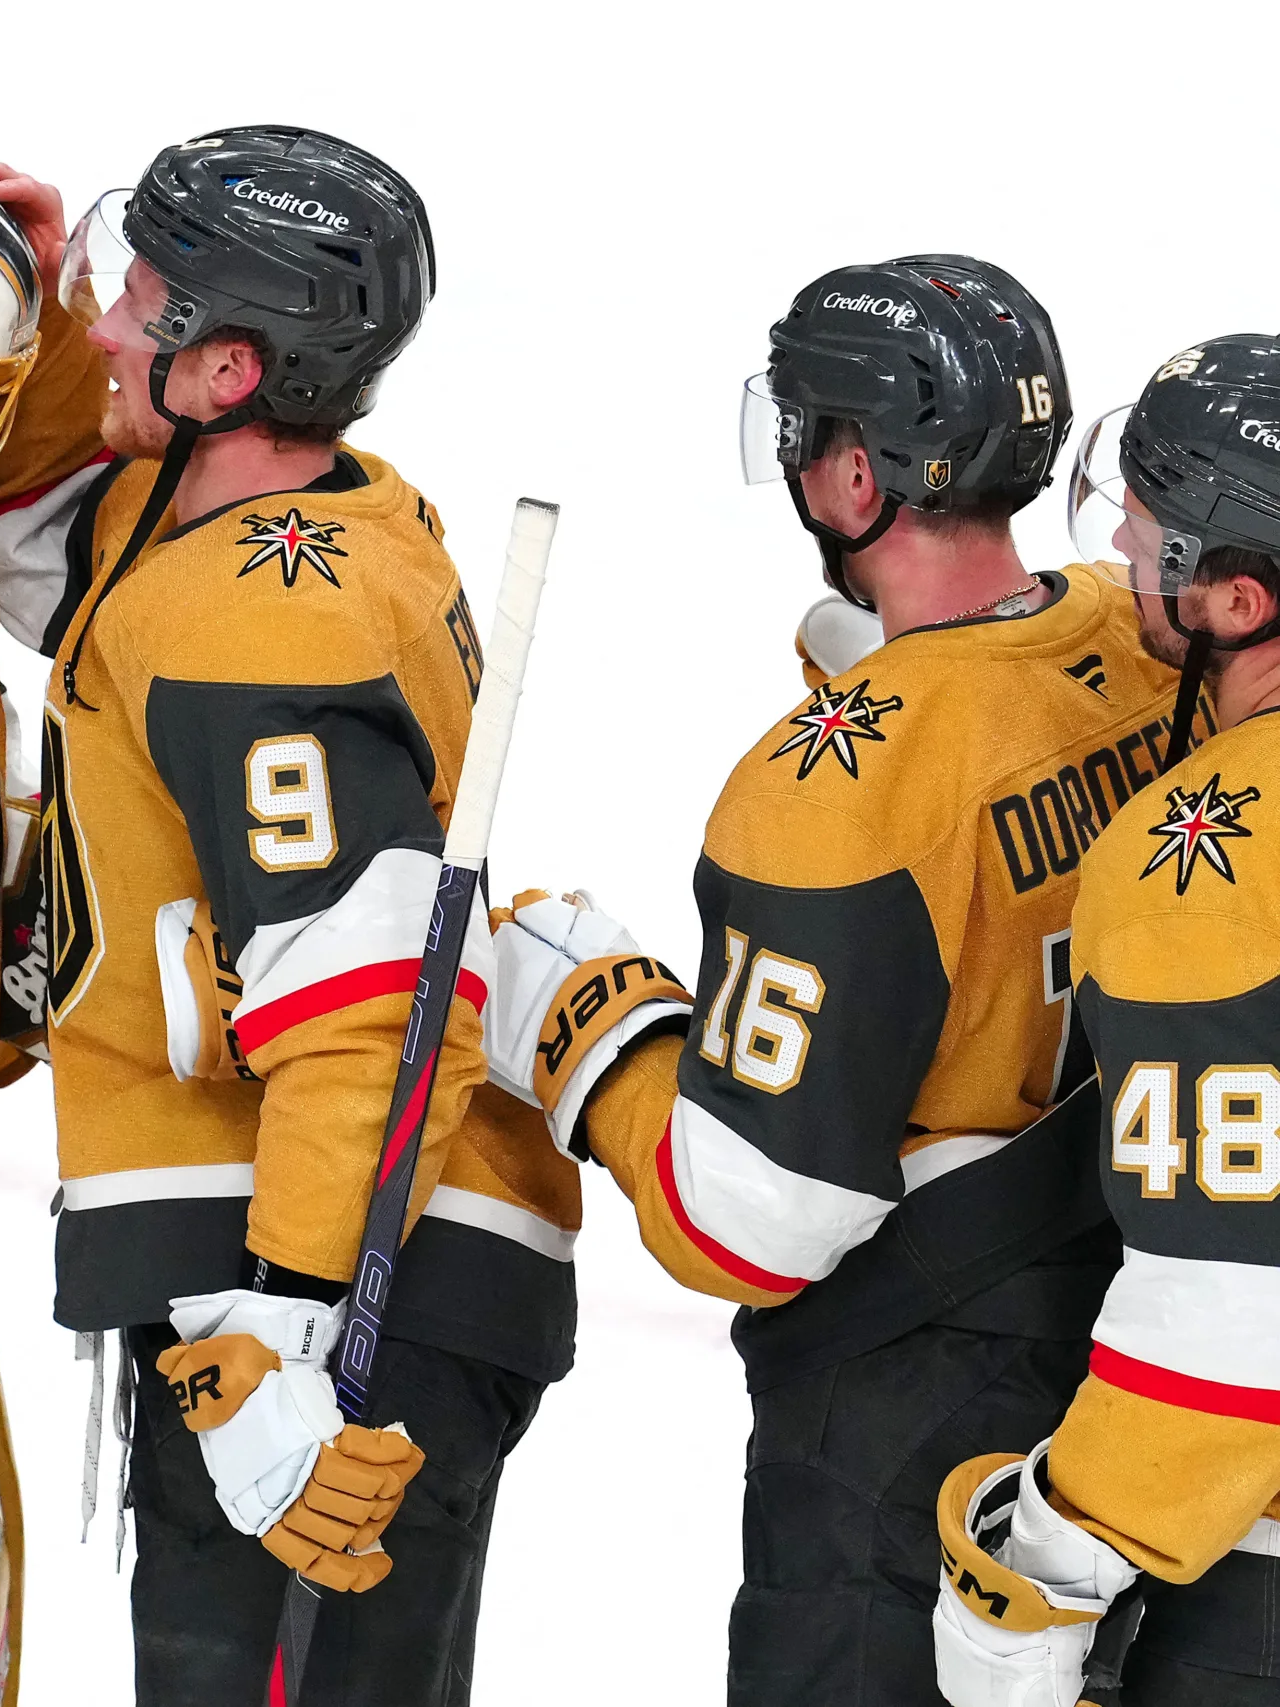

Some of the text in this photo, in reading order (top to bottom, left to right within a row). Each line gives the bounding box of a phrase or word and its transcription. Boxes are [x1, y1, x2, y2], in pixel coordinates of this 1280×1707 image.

[233, 182, 350, 230] CreditOne
[822, 292, 917, 321] CreditOne
[1015, 374, 1053, 425] 16
[244, 733, 340, 874] 9
[698, 925, 827, 1096] 16
[1111, 1061, 1280, 1202] 48
[301, 1317, 316, 1356] EICHEL
